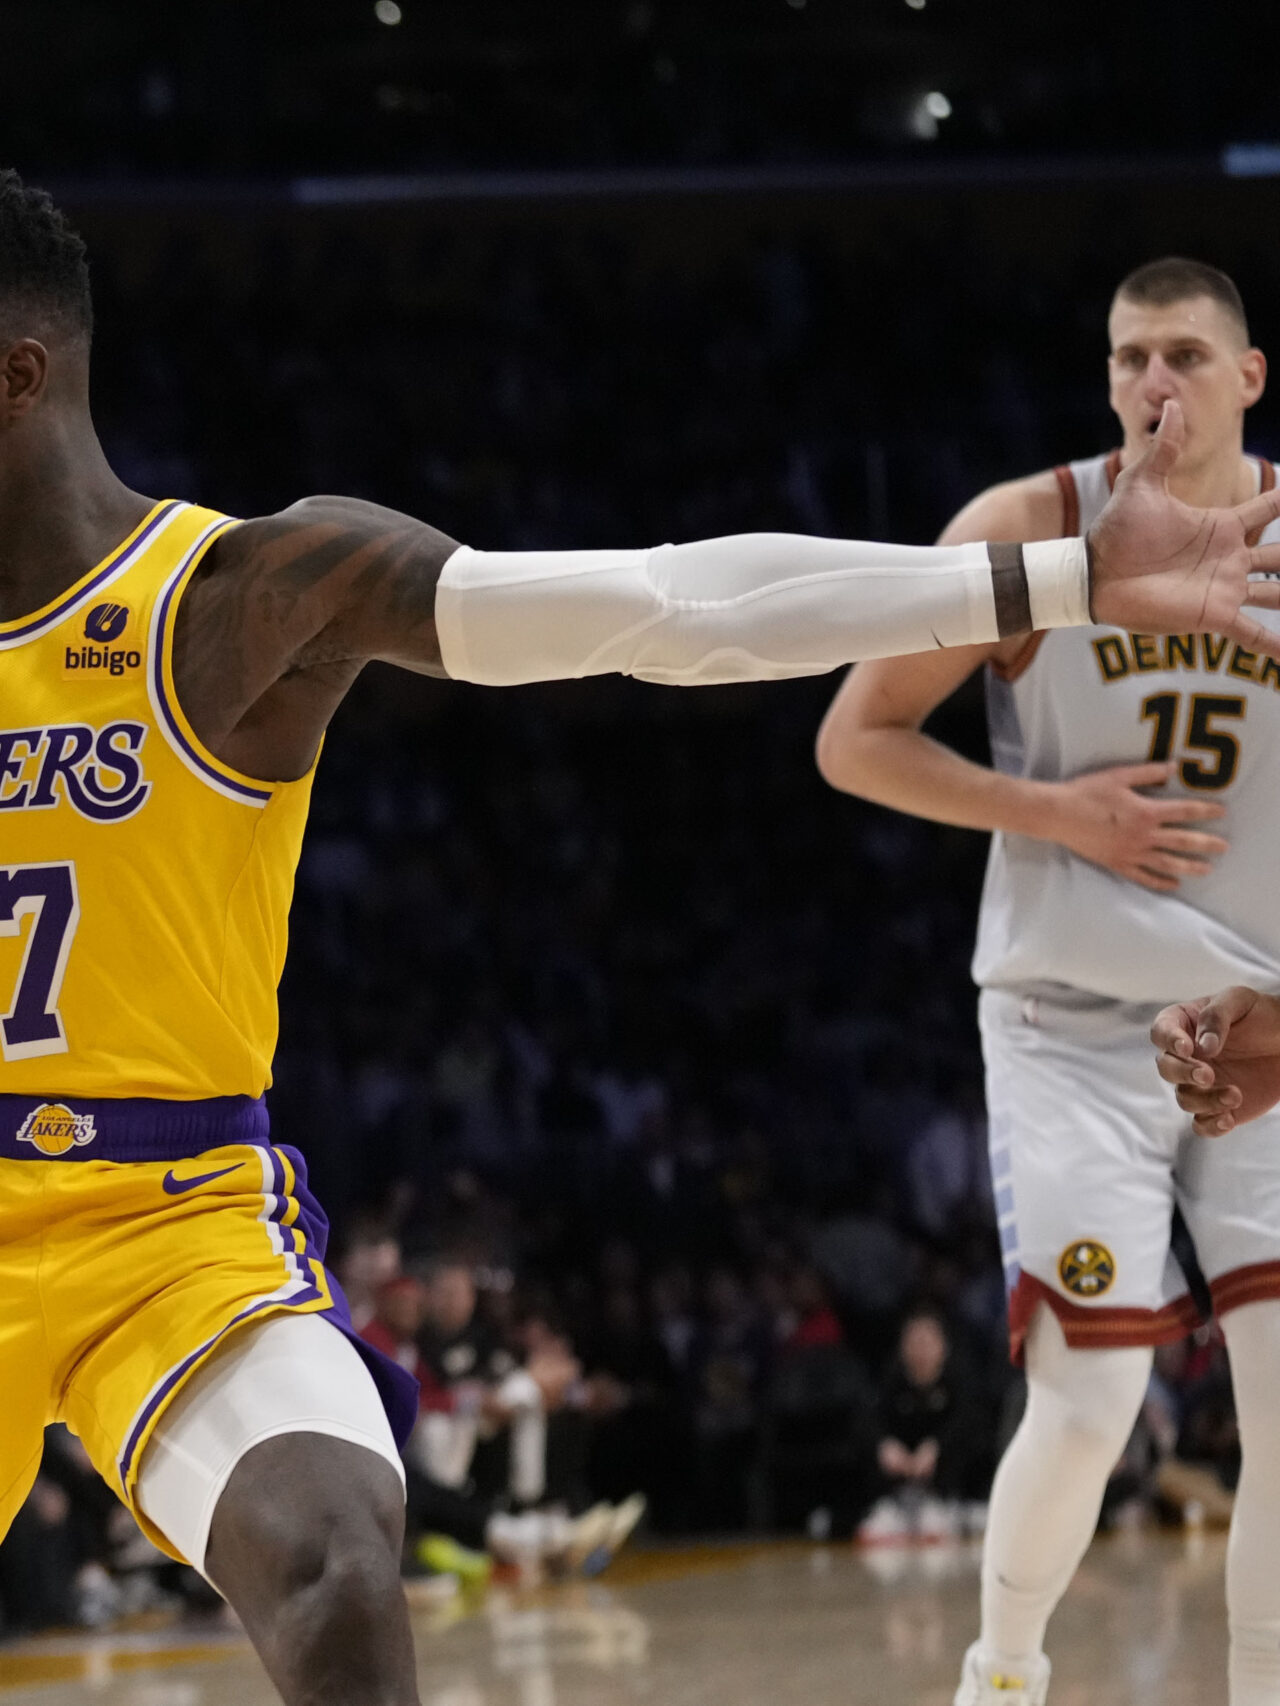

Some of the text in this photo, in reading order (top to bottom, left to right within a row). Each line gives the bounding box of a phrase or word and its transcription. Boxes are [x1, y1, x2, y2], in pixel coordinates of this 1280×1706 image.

[65, 646, 141, 676] bibigo
[1140, 691, 1247, 793] 15
[18, 1114, 96, 1145] LAKERS
